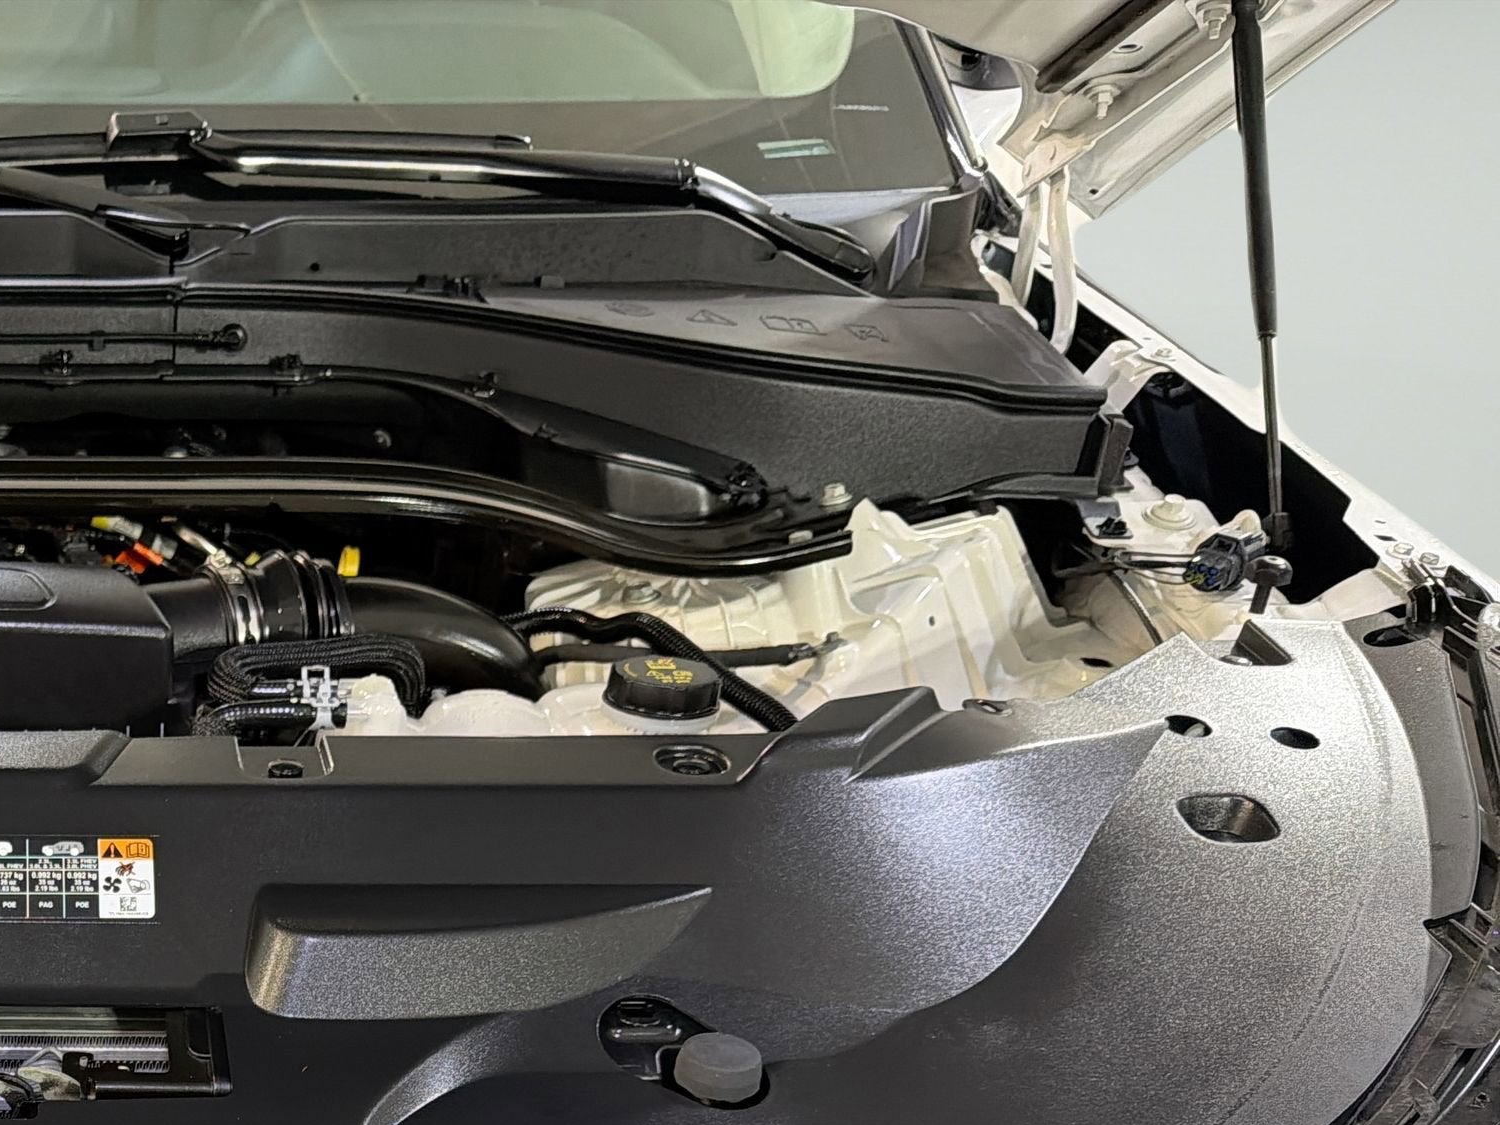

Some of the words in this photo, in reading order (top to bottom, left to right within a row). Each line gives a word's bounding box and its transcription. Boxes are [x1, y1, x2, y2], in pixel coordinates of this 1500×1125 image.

[13, 872, 24, 880] kg
[52, 872, 61, 880] kg
[87, 872, 97, 880] kg
